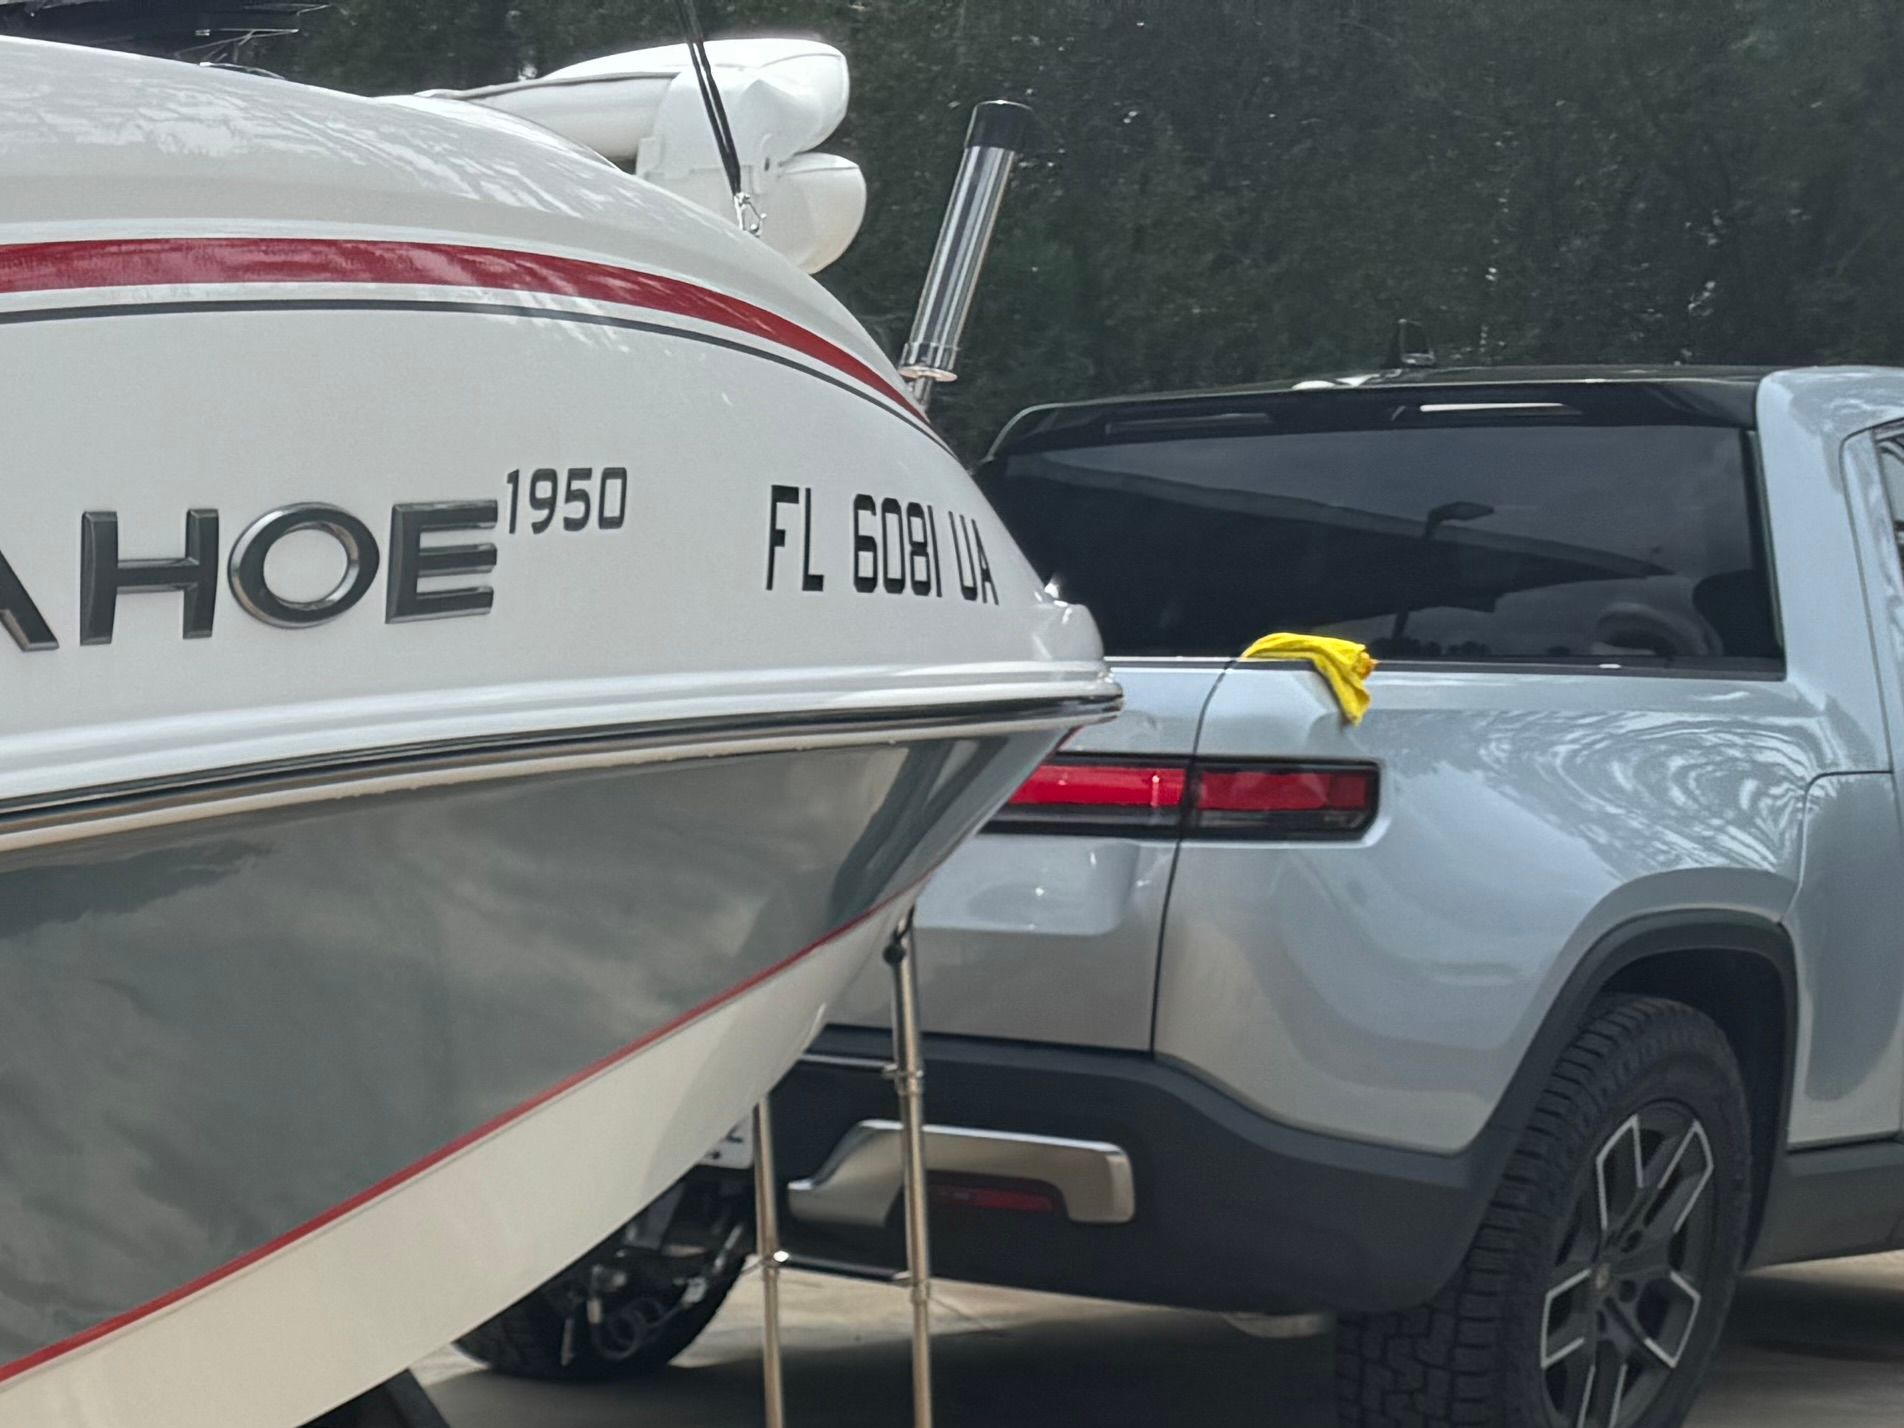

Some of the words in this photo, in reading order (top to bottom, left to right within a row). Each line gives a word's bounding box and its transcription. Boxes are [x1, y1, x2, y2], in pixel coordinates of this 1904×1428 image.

[506, 467, 628, 535] 1950
[766, 484, 825, 592] FL
[853, 493, 943, 599] 6081
[948, 510, 1000, 606] UA
